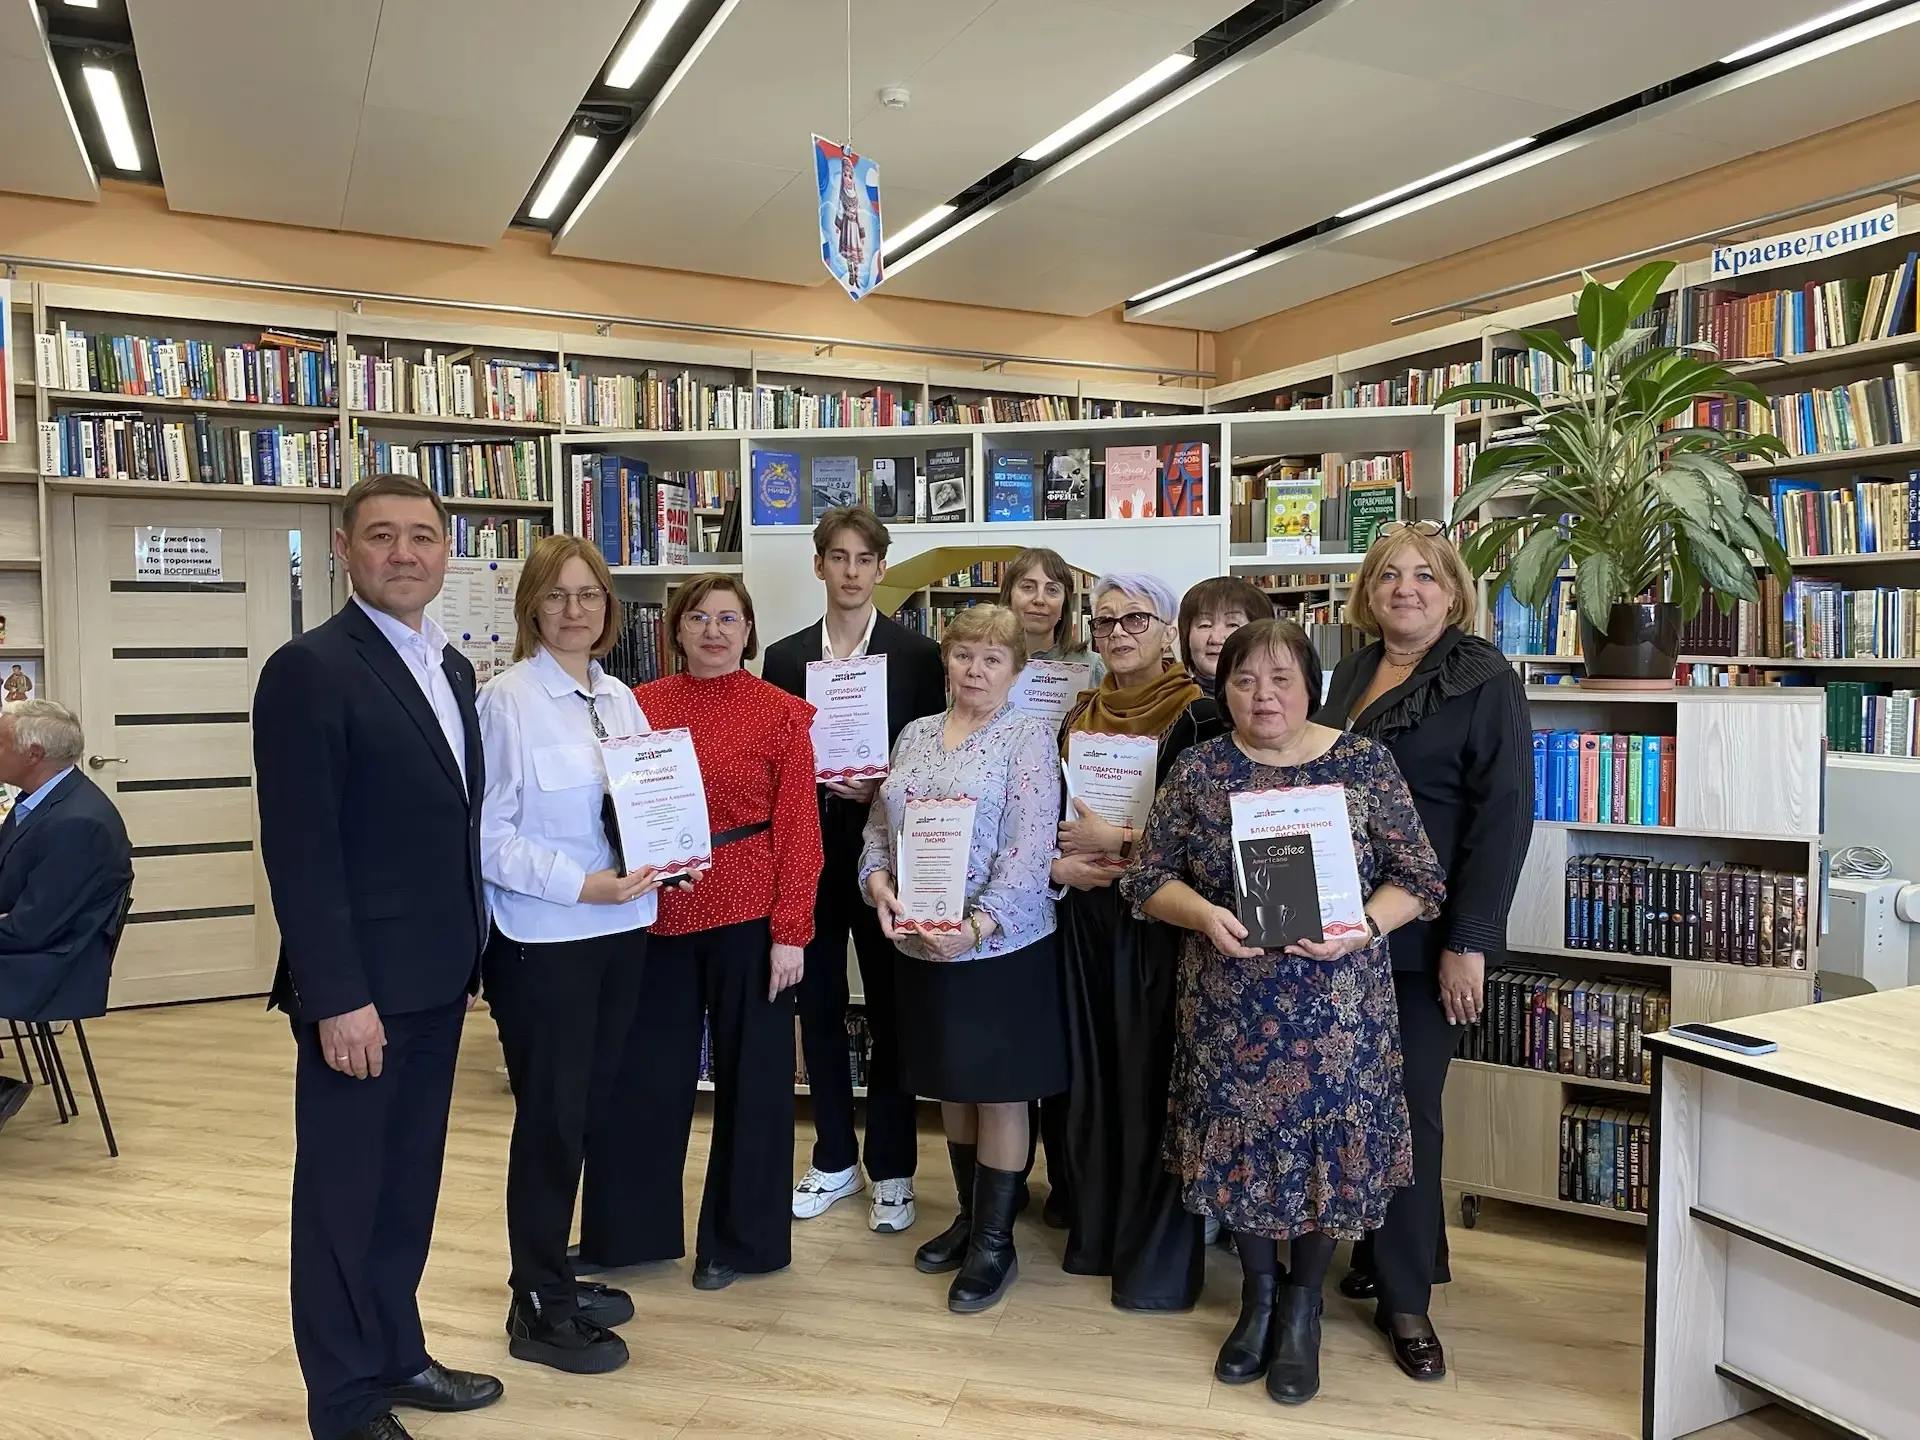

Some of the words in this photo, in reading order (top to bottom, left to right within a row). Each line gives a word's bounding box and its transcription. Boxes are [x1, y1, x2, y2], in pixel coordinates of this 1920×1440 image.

[1713, 213, 1895, 275] Краеведение
[1173, 456, 1200, 465] ЛЮБОВЬ
[1047, 493, 1078, 501] ФРЕЙД
[1353, 496, 1394, 507] СПРАВОЧНИК
[146, 557, 212, 565] Поторонним
[825, 686, 867, 696] СЕРТИФИКАТ
[1023, 689, 1068, 699] СЕРТИФИКАТ
[1079, 764, 1143, 777] БЛАГОДАРСТВЕННОЕ
[1095, 773, 1122, 781] ПИСЬМО
[1250, 820, 1333, 835] БЛАГОДАРСТВЕННОЕ
[911, 830, 962, 838] БЛАГОДАРСТВЕННОЕ
[1267, 845, 1305, 857] Coffee
[1562, 1022, 1571, 1049] ВОРОН
